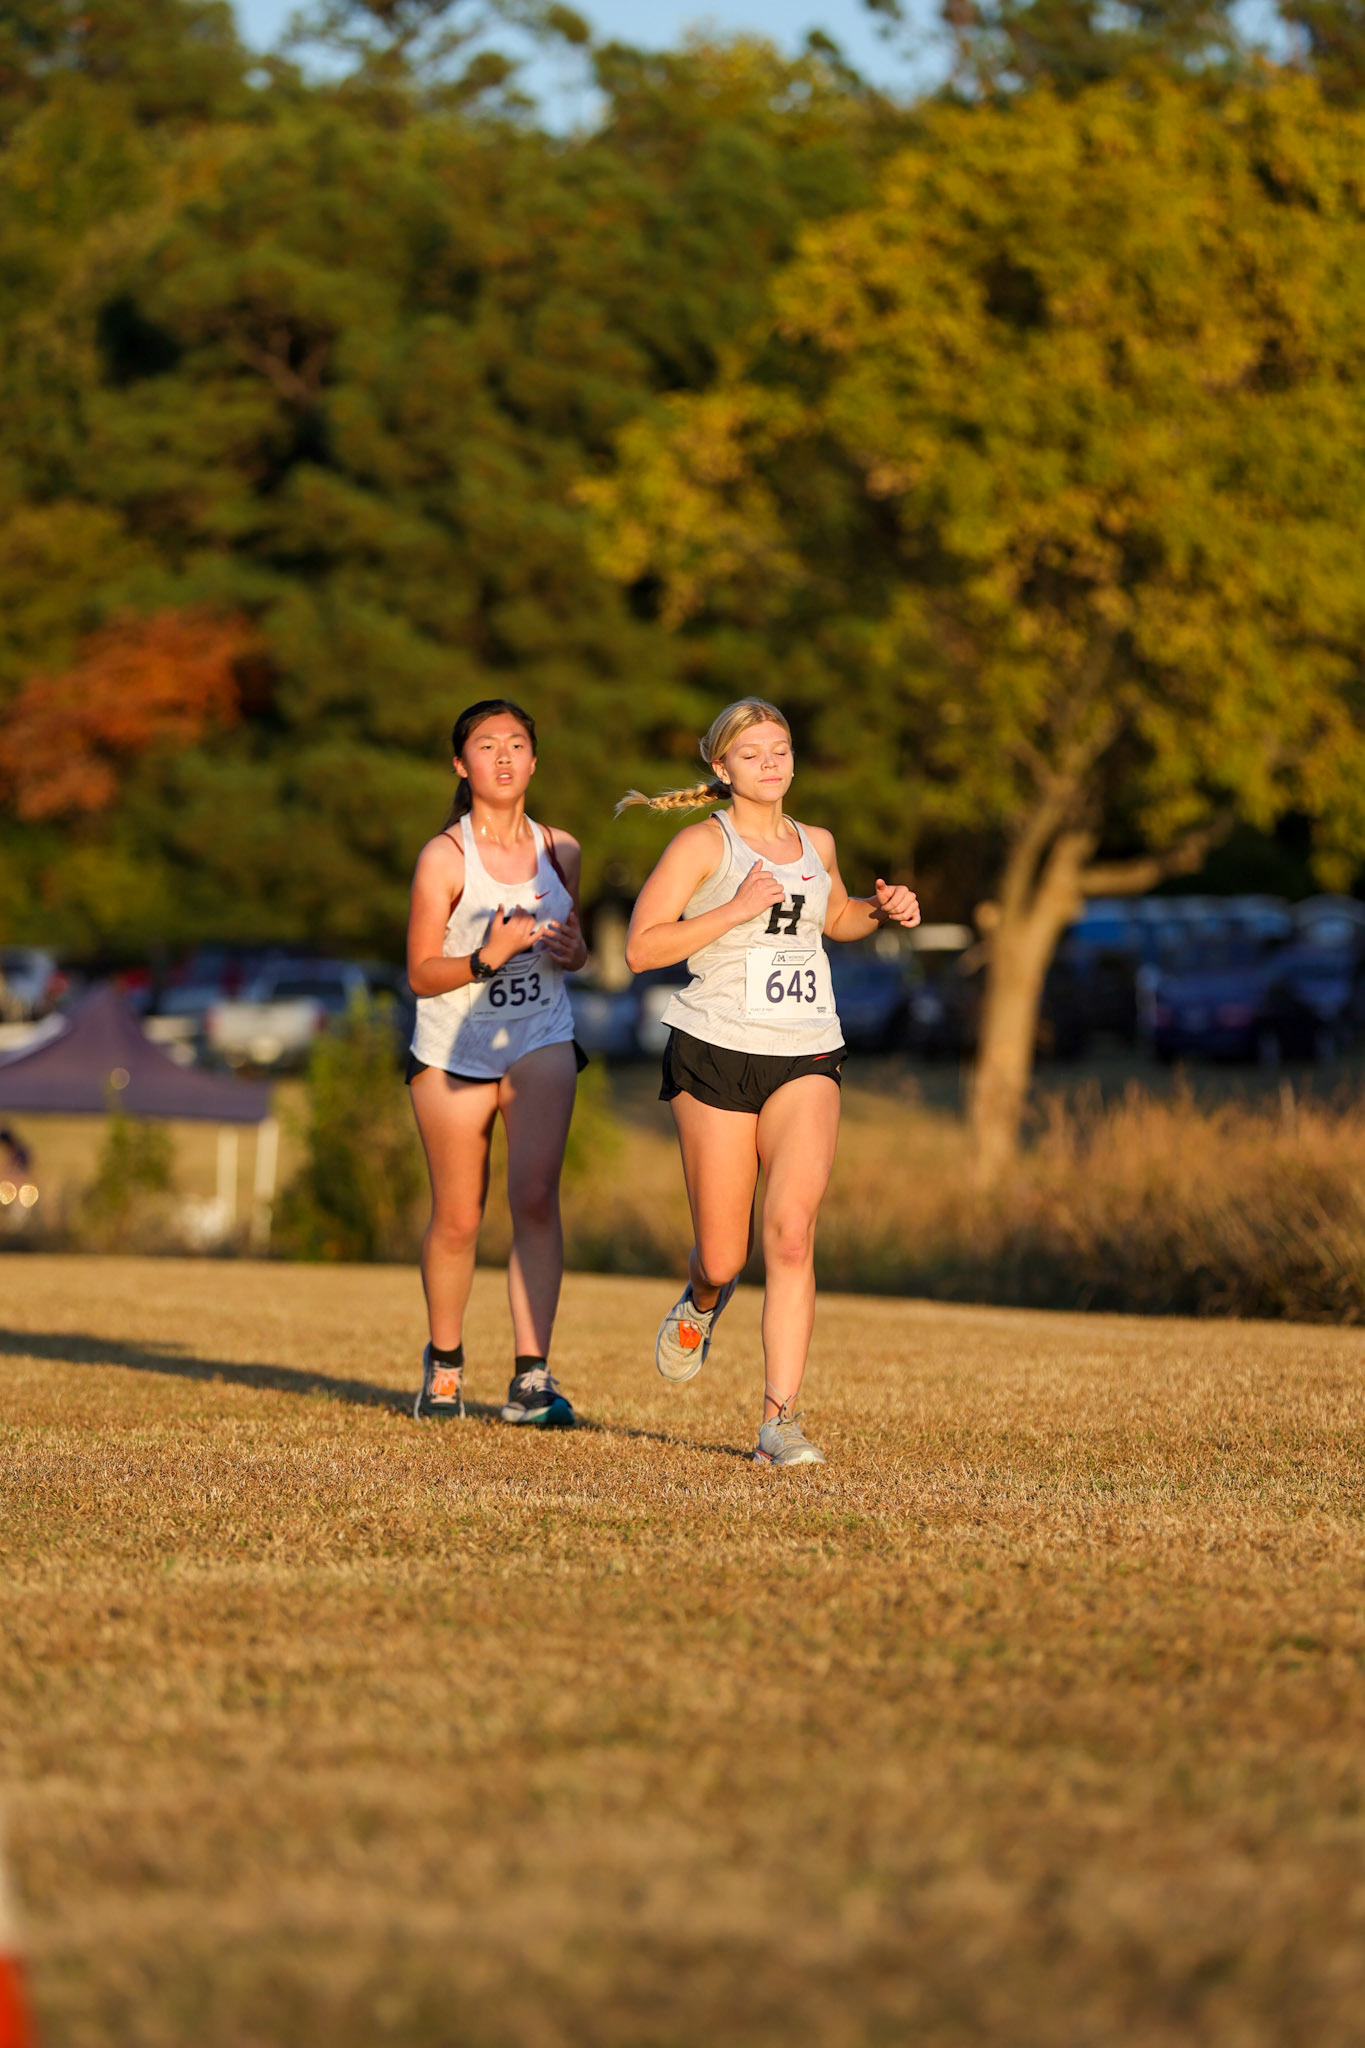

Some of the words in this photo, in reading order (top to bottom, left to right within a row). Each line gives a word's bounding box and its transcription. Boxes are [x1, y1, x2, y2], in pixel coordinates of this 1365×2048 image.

[765, 894, 805, 935] H
[489, 972, 541, 1007] 653
[766, 970, 816, 1003] 643
